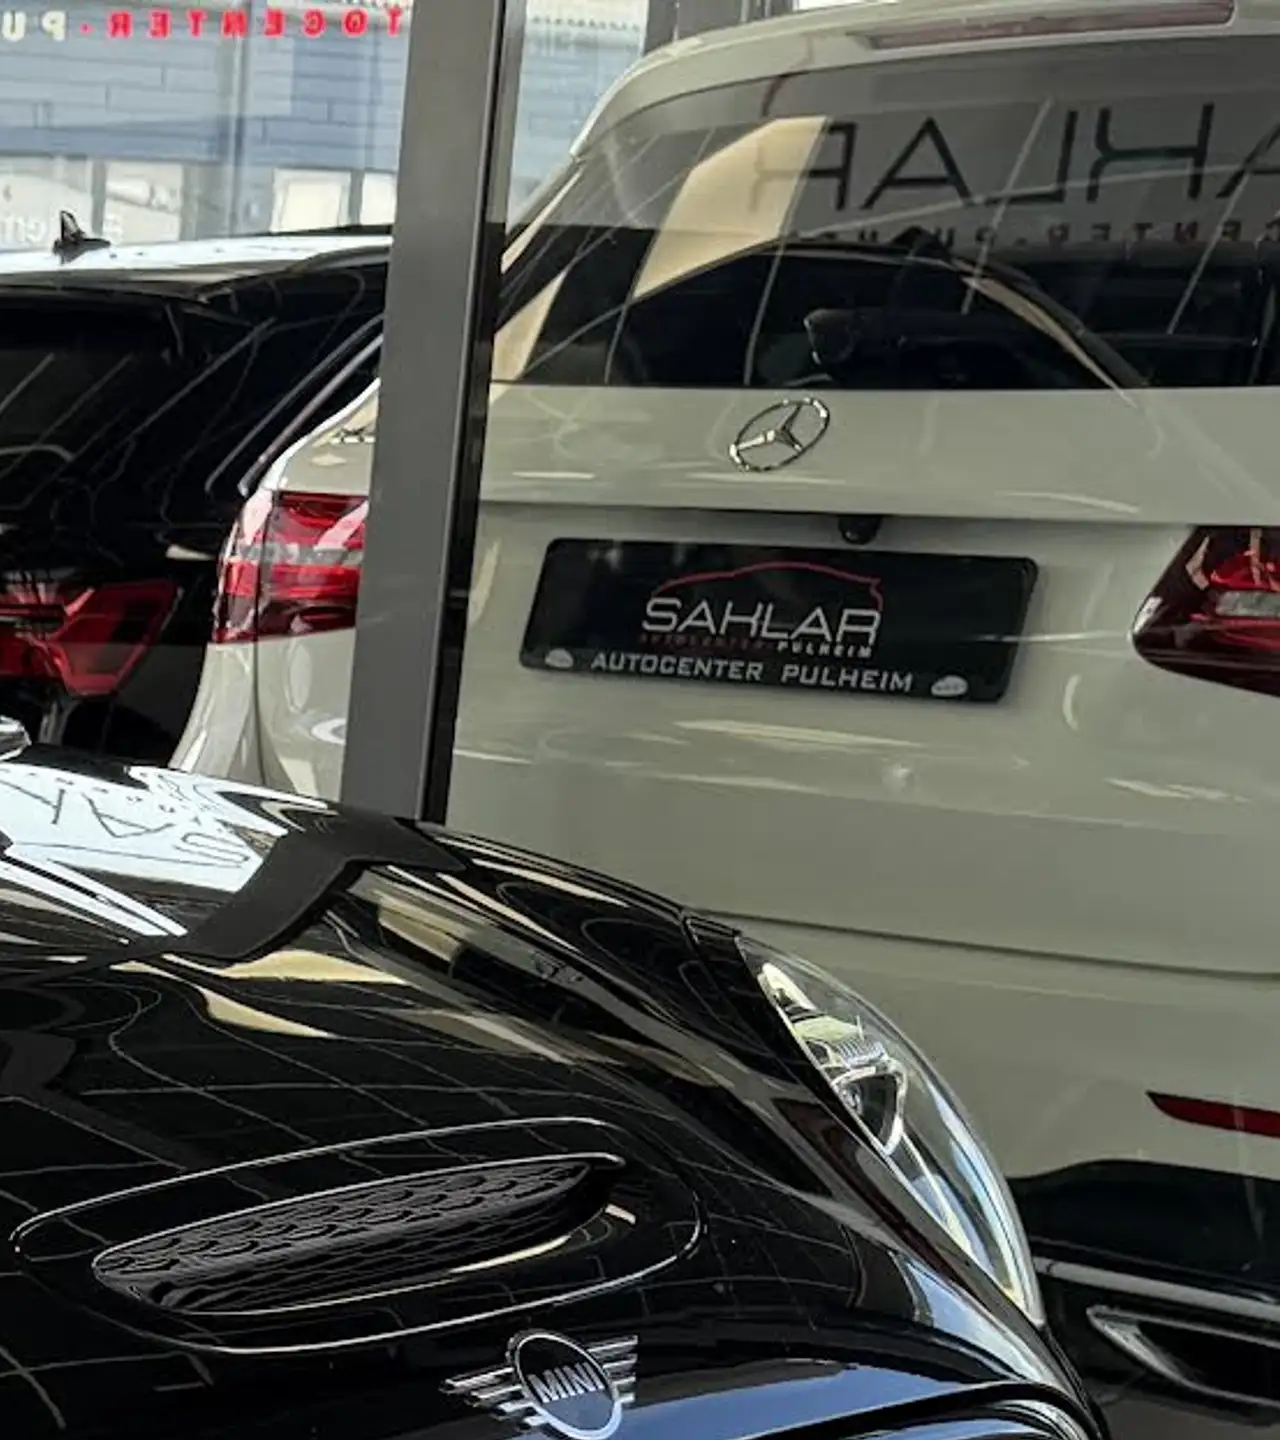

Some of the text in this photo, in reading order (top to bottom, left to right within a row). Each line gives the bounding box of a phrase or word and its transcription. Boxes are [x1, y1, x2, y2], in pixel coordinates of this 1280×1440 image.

[642, 597, 881, 646] SAHLAR
[777, 640, 872, 658] PULHEIM
[590, 650, 764, 682] AUTOCENTER
[780, 663, 914, 694] PULHEIM
[526, 1360, 606, 1404] MINI
